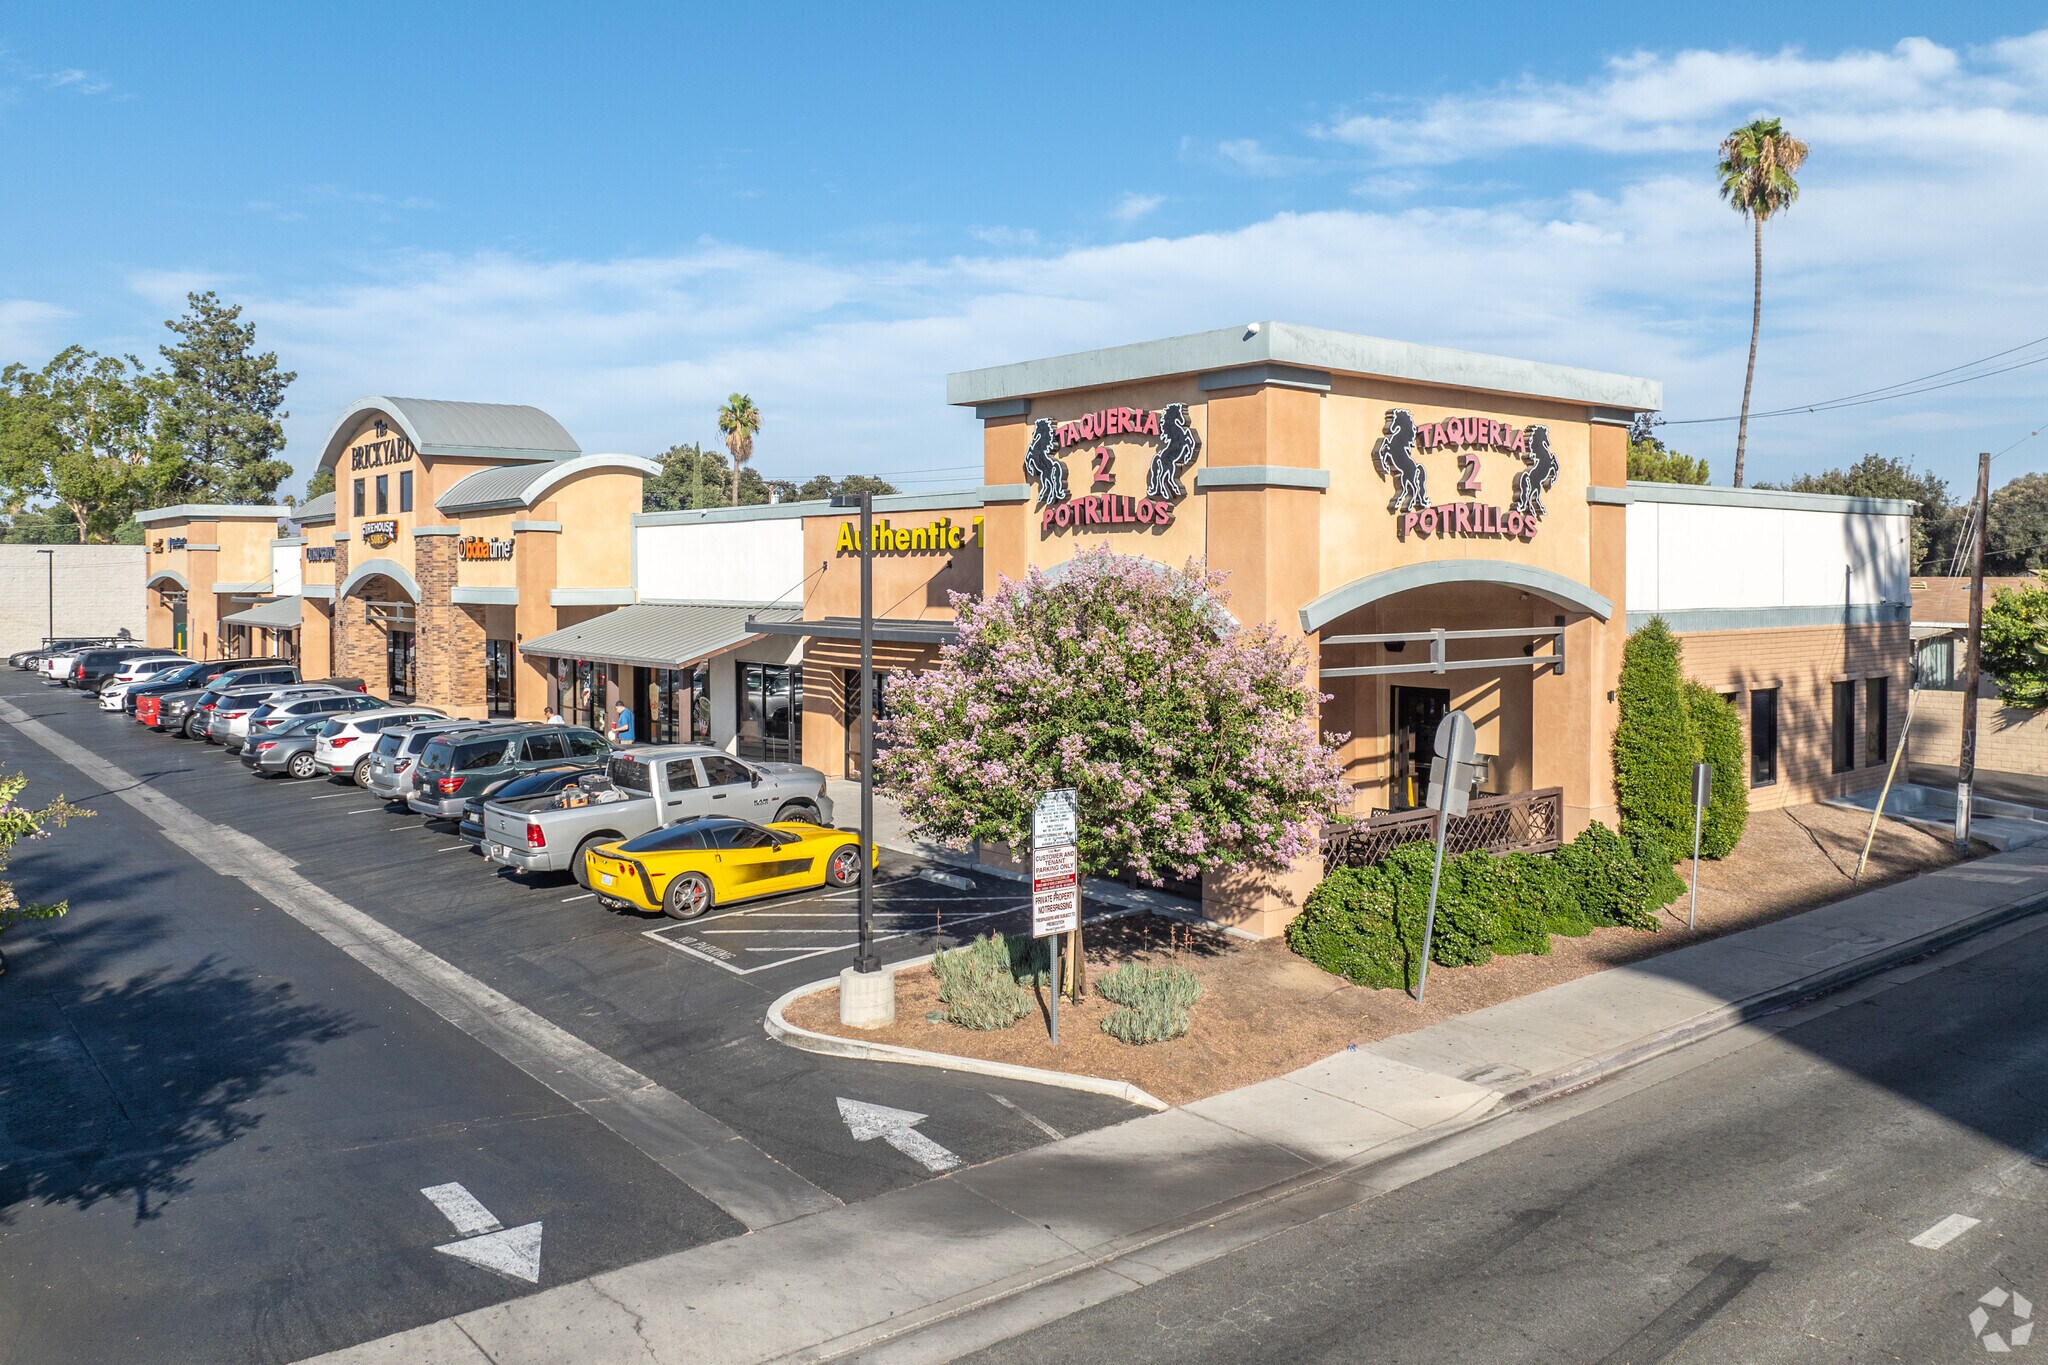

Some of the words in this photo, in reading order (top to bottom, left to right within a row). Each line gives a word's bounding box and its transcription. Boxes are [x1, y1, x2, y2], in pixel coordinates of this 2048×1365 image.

[375, 419, 387, 438] The
[1055, 407, 1159, 447] TAQUERIA
[1417, 416, 1526, 453] TAQUERIA
[351, 437, 414, 471] BRICKYARD
[1094, 447, 1110, 482] 2
[1463, 453, 1481, 491] 2
[1043, 493, 1170, 531] POTRILLOS
[1404, 502, 1538, 538] POTRILLOS
[362, 521, 394, 540] FIREHOUSE
[371, 534, 383, 544] SUBS
[1036, 852, 1063, 862] CUSTOMER
[1045, 858, 1065, 866] TENANT
[1036, 865, 1059, 873] PARKING
[1035, 895, 1053, 905] PRIVATE
[1053, 892, 1075, 901] PROPERTY
[1038, 906, 1044, 914] NO
[1044, 901, 1072, 912] TRESPASSING
[690, 941, 737, 960] PARKING
